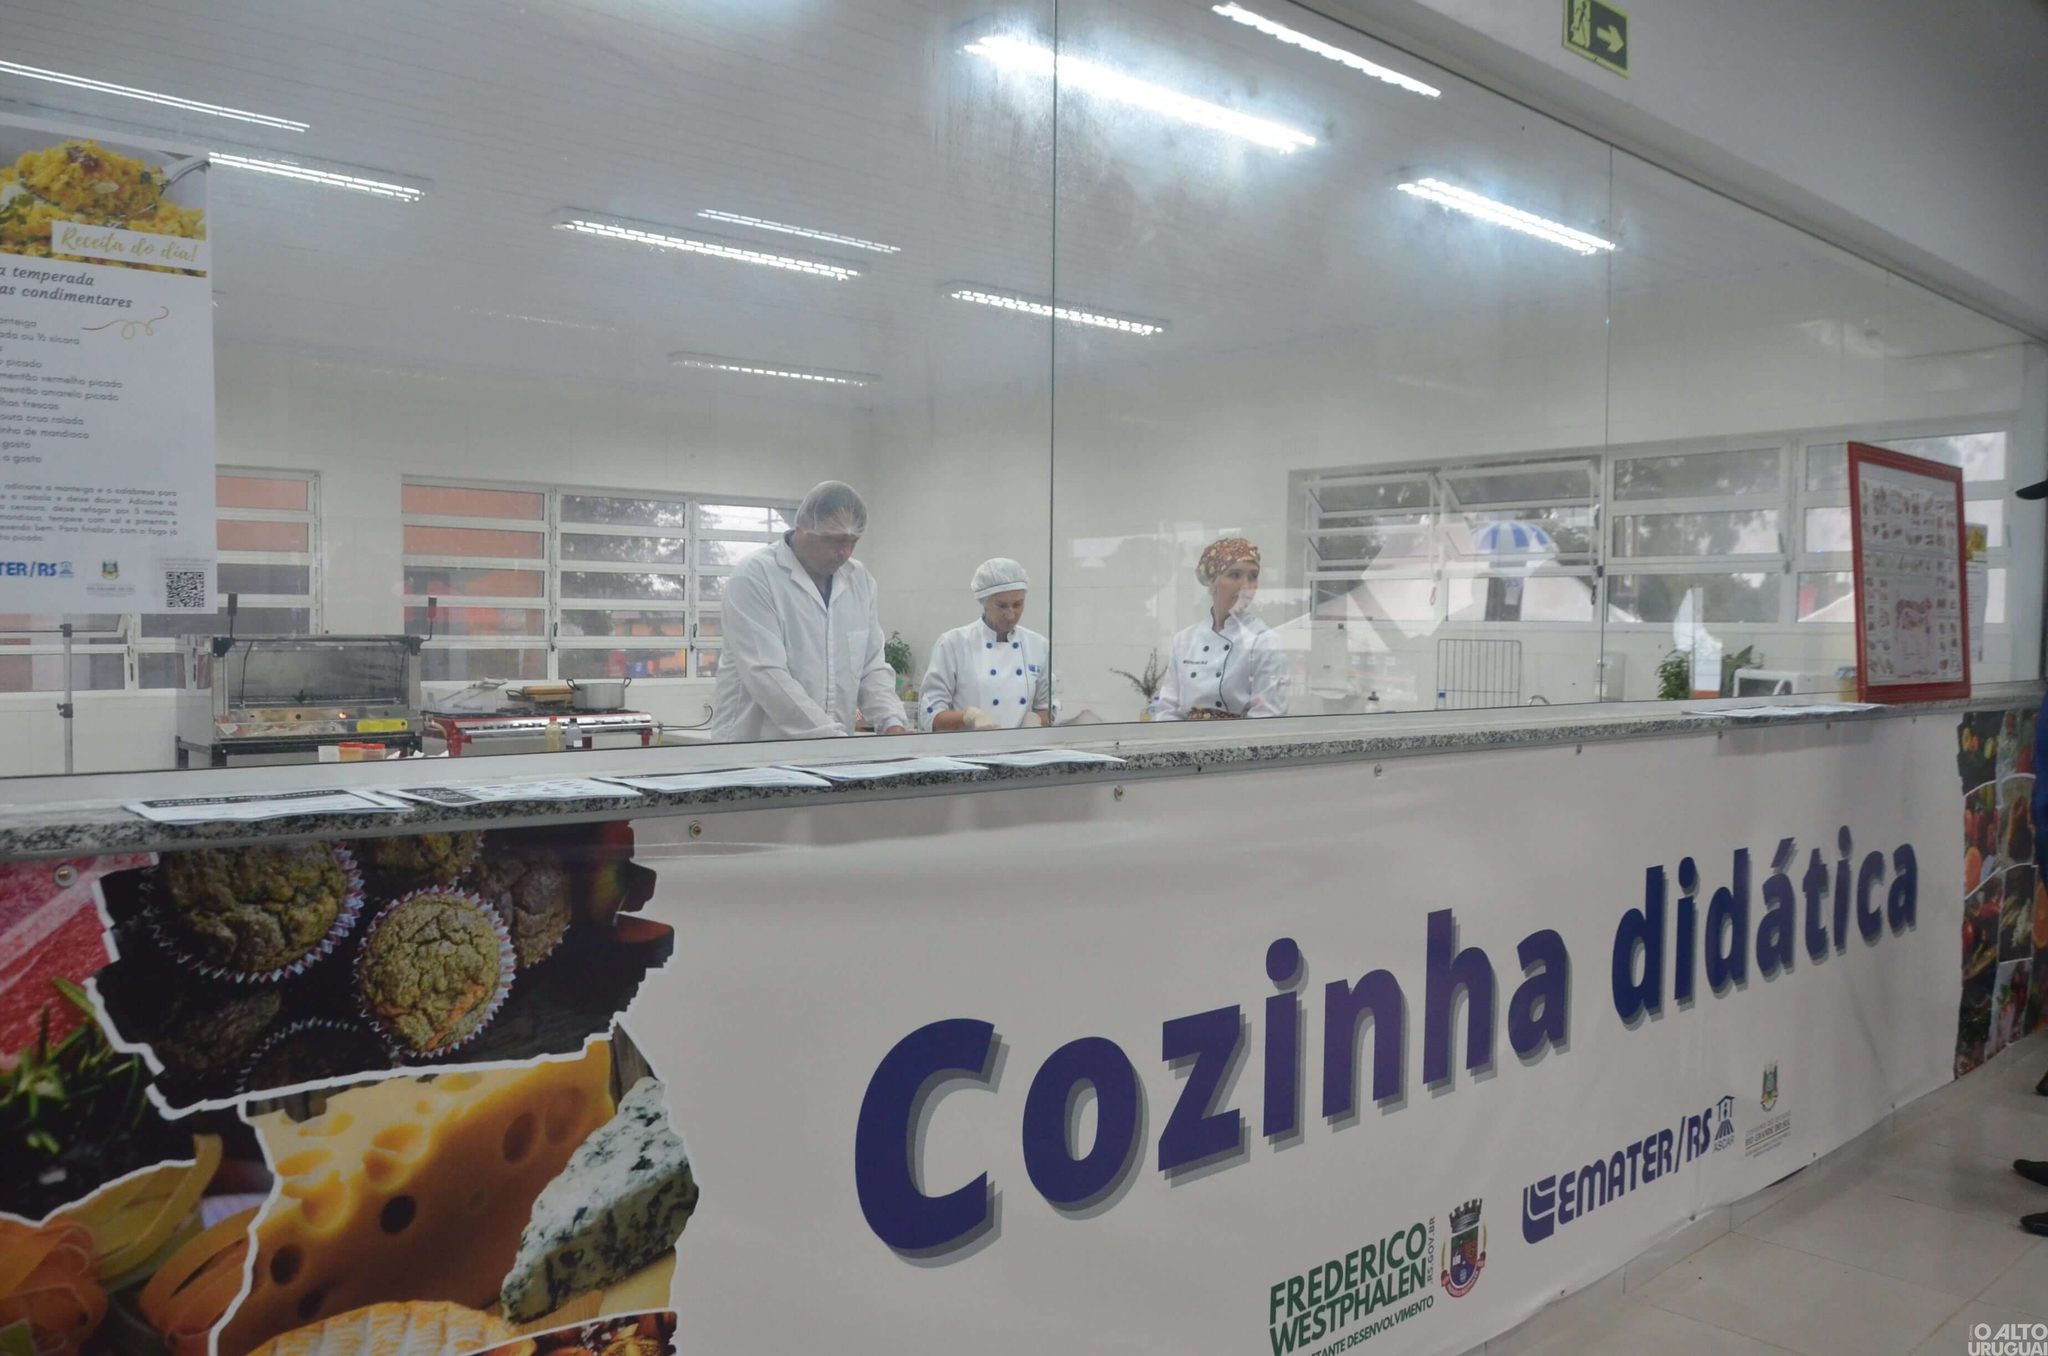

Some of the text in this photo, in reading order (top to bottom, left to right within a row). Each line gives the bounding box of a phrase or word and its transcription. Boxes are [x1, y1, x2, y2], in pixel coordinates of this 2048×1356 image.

[61, 226, 199, 262] Receita do dia!
[12, 267, 94, 286] temperada
[21, 287, 133, 308] condimentares
[6, 359, 42, 368] picado
[88, 380, 123, 388] picado
[41, 390, 82, 398] amarelo
[84, 393, 119, 402] picado
[22, 400, 59, 410] frescas
[51, 416, 84, 425] ralada
[23, 427, 37, 435] de
[40, 430, 90, 439] mandioca
[2, 441, 31, 450] gosto
[12, 455, 42, 465] gosto
[855, 826, 1920, 1262] Cozinha didática
[1558, 1107, 1713, 1225] EMATER/RS
[1269, 1222, 1427, 1325] FREDERICO
[1269, 1257, 1427, 1356] WESTPHALEN
[1347, 1295, 1434, 1349] DESENVOLVIMENTO
